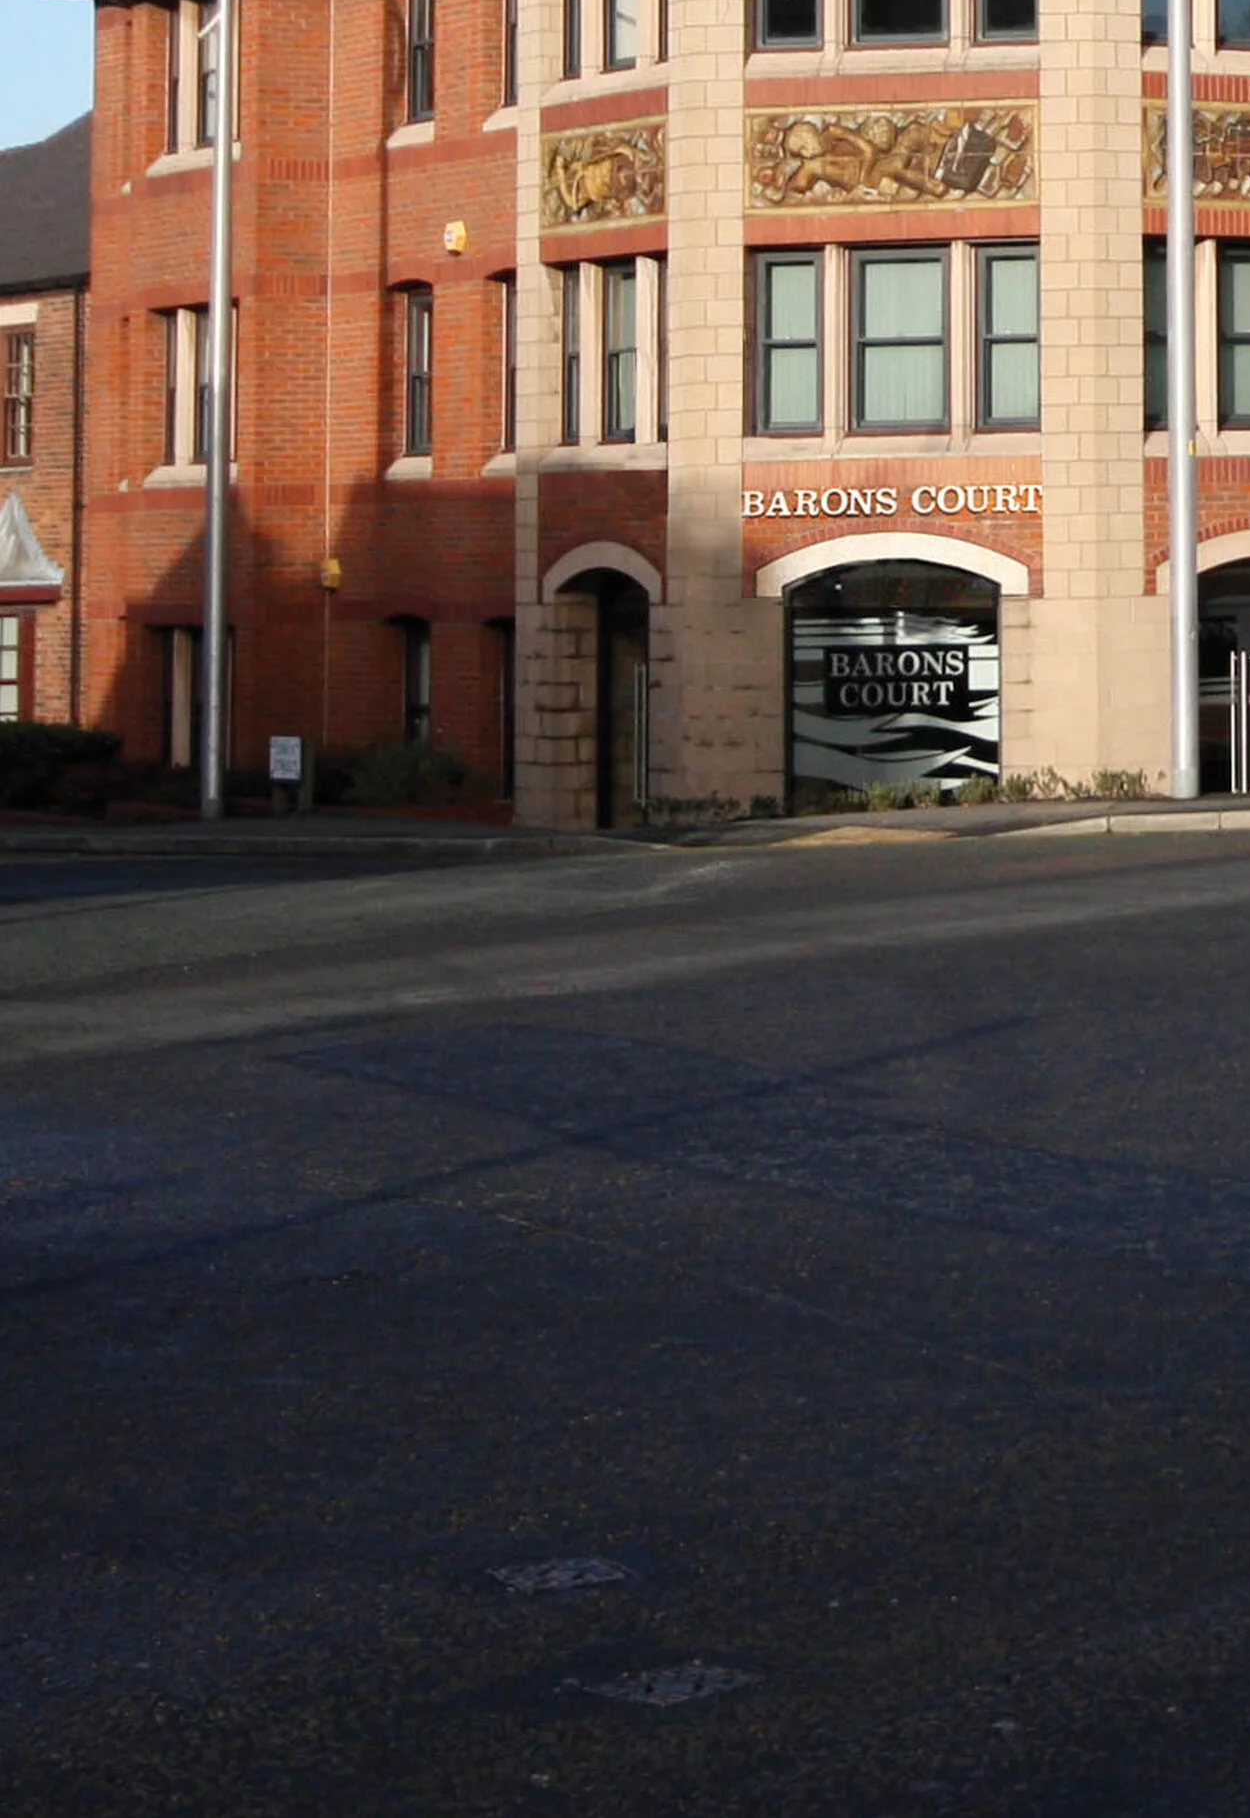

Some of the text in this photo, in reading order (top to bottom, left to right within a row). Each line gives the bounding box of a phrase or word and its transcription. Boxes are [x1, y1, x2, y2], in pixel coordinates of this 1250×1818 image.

[742, 484, 1043, 517] BARONS COURT
[830, 650, 964, 676] BARONS
[840, 681, 954, 707] COURT
